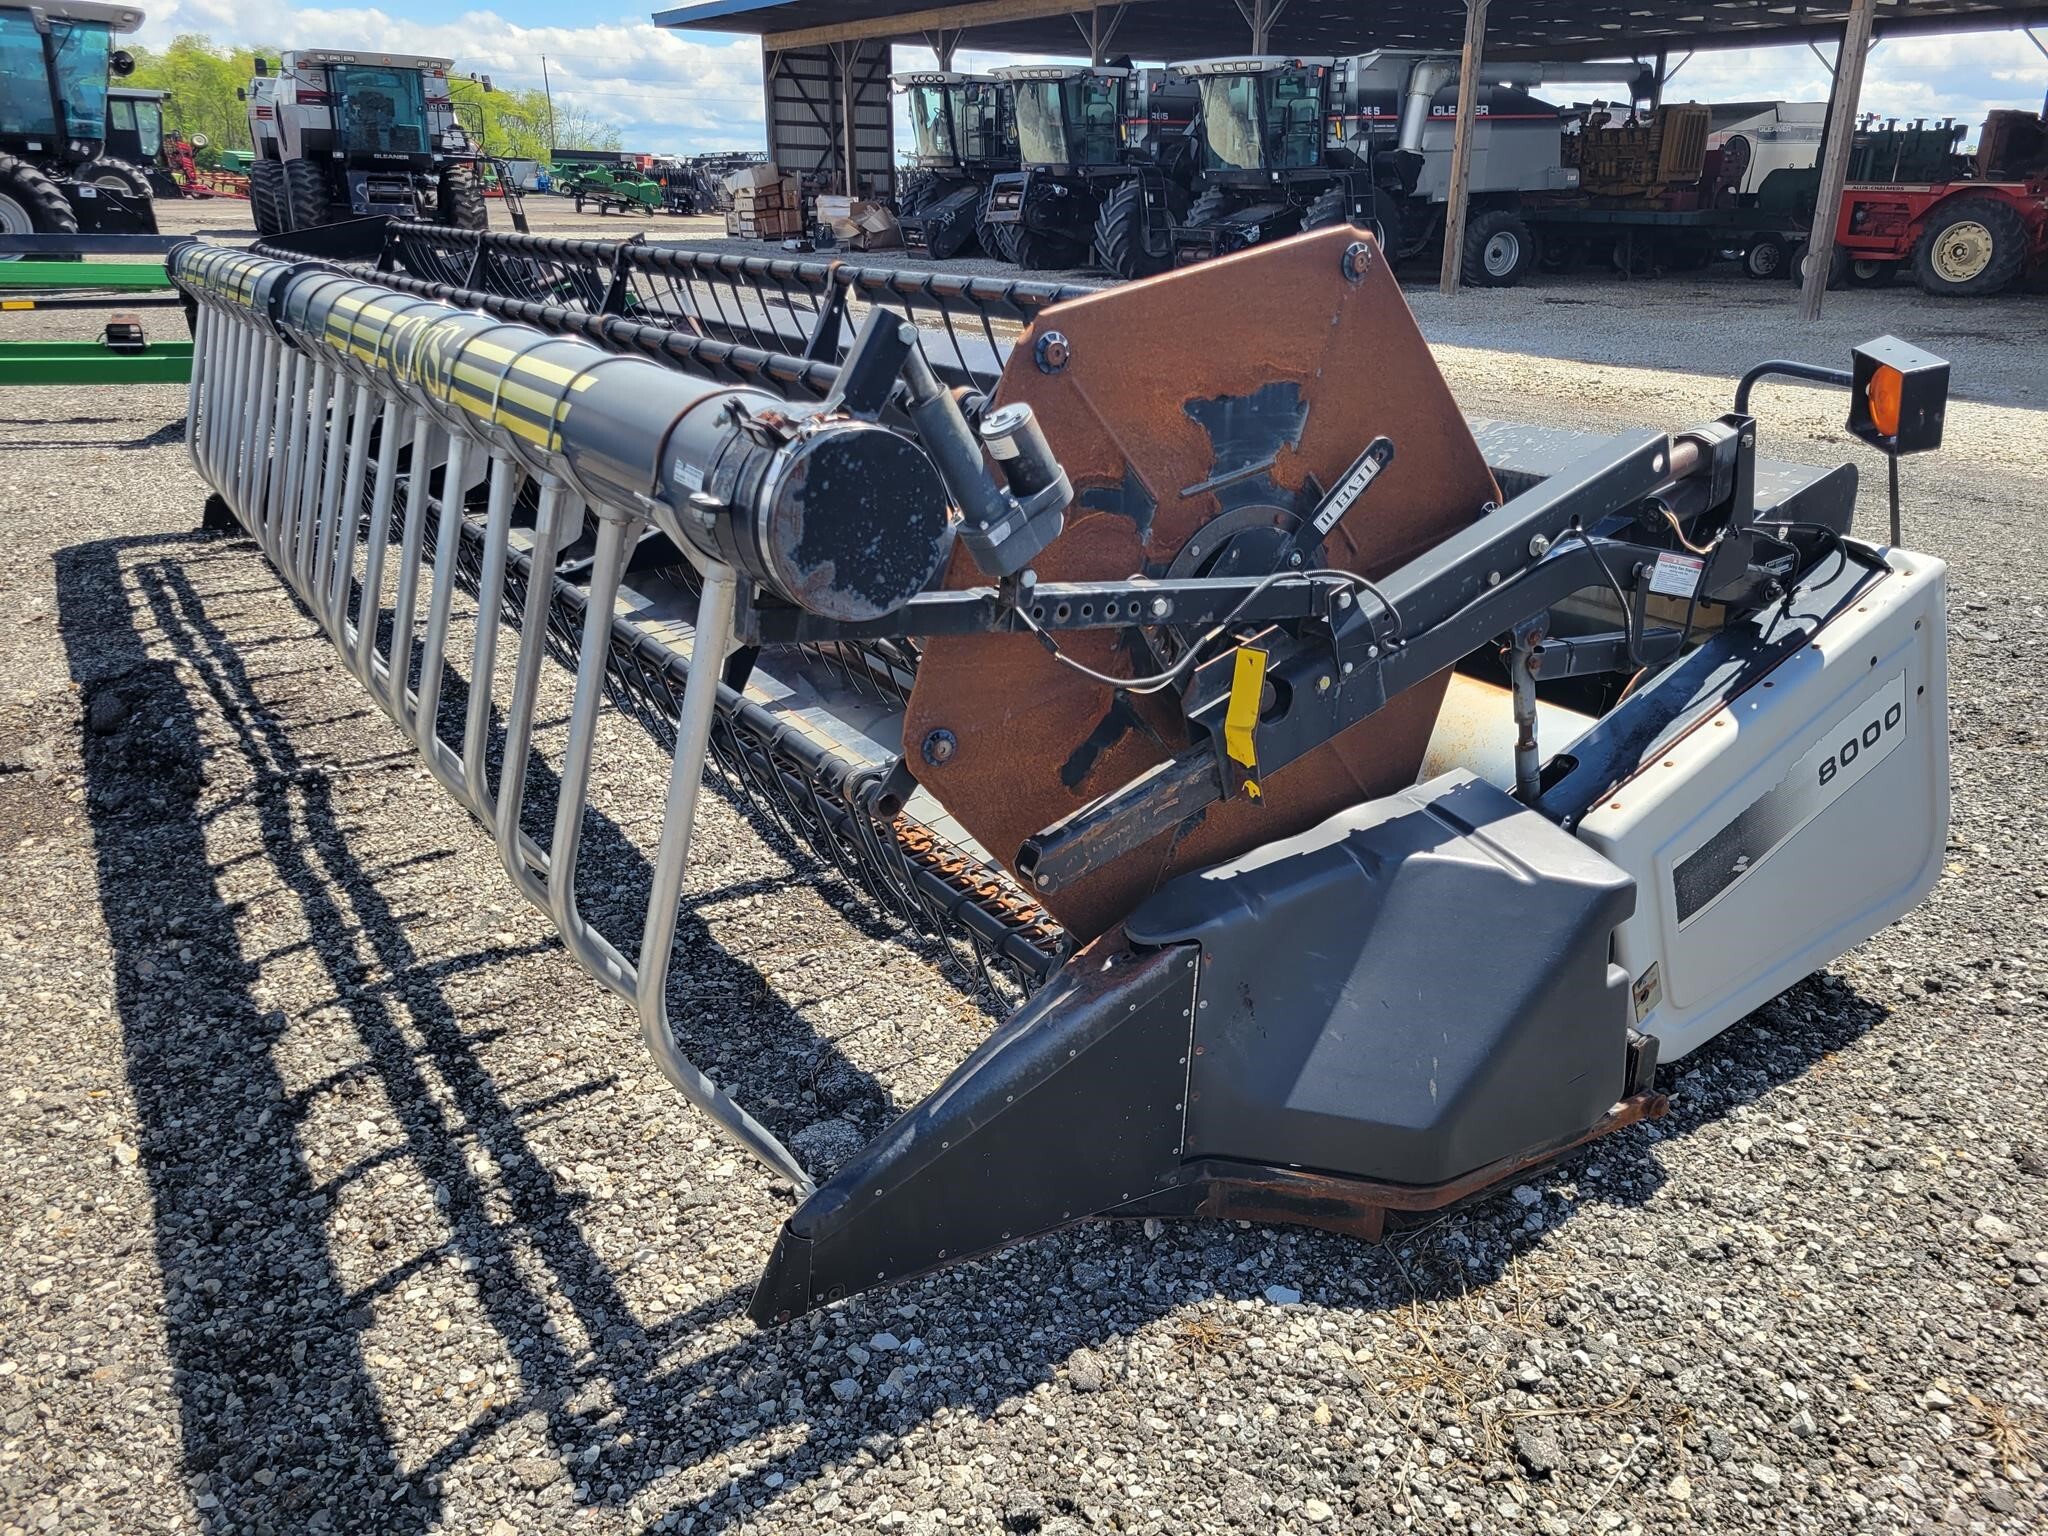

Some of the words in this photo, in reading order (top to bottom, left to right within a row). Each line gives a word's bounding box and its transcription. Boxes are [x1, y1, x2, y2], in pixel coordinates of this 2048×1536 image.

[1433, 105, 1489, 116] GLEER
[1331, 464, 1373, 510] LEVEL
[1818, 702, 1902, 786] 8000
